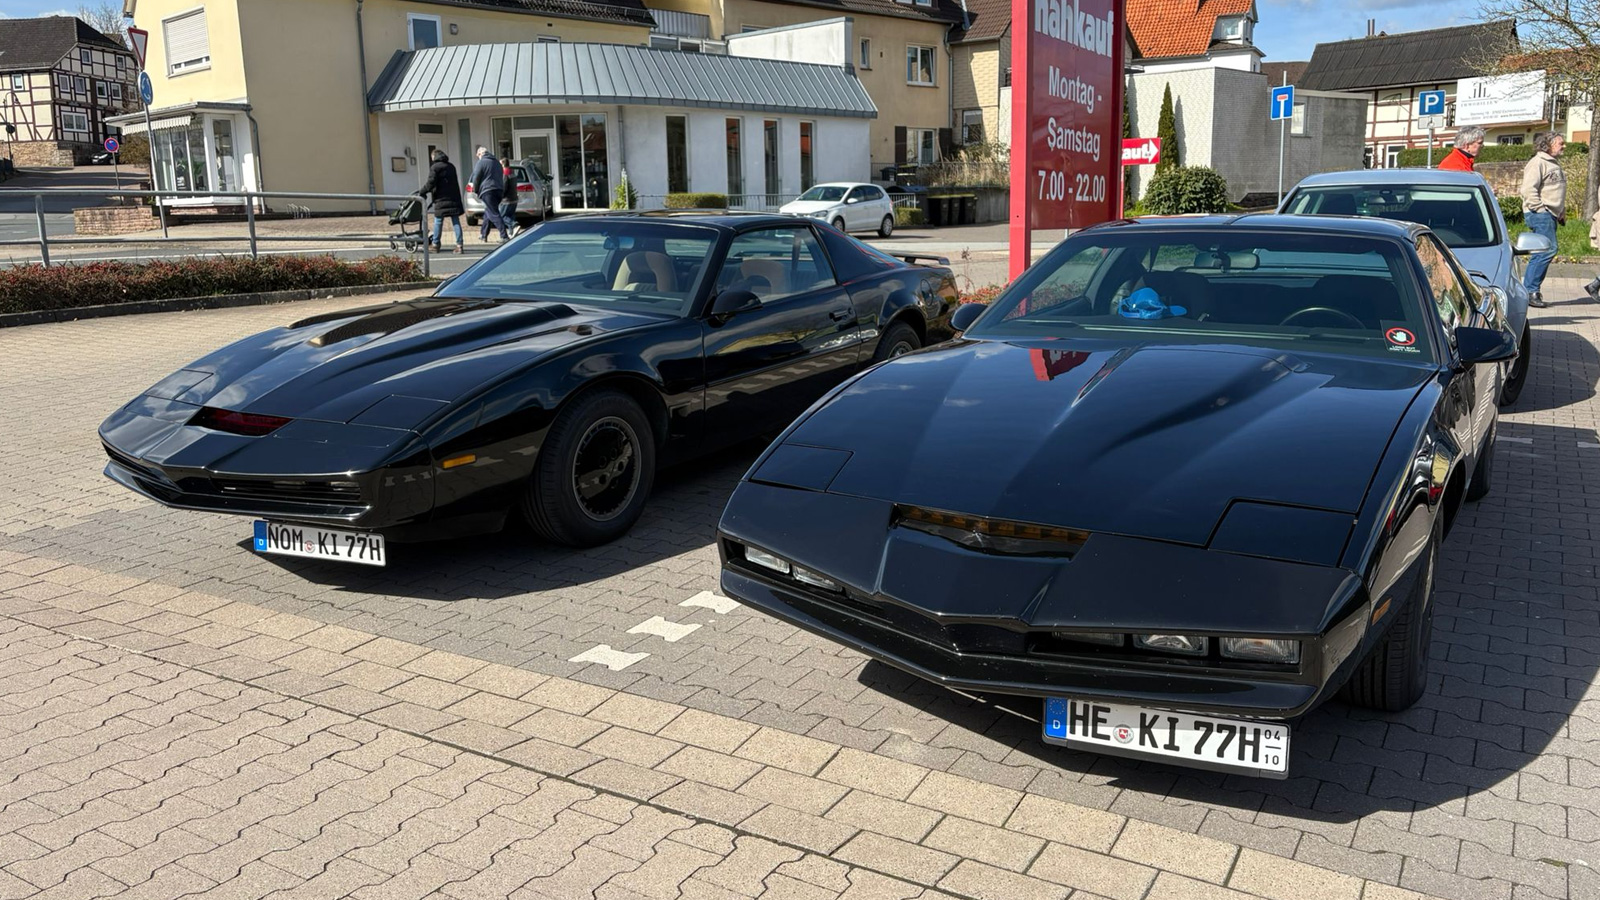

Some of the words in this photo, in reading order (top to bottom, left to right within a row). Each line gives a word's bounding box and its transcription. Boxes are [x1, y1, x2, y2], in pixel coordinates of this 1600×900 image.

[1035, 0, 1114, 58] nahkauf
[1049, 65, 1095, 114] Montag
[1425, 95, 1439, 112] P
[1048, 117, 1100, 162] Samstag
[1122, 143, 1149, 160] auf
[1038, 170, 1065, 201] 7.00
[1076, 173, 1105, 202] 22.00
[268, 523, 303, 551] NOM
[318, 531, 340, 556] KI
[345, 535, 381, 561] 77H
[1053, 719, 1061, 729] D
[1069, 701, 1111, 741] HE
[1139, 712, 1180, 752] KI
[1194, 720, 1260, 763] 77H
[1264, 729, 1281, 741] 04
[1264, 753, 1280, 765] 10
